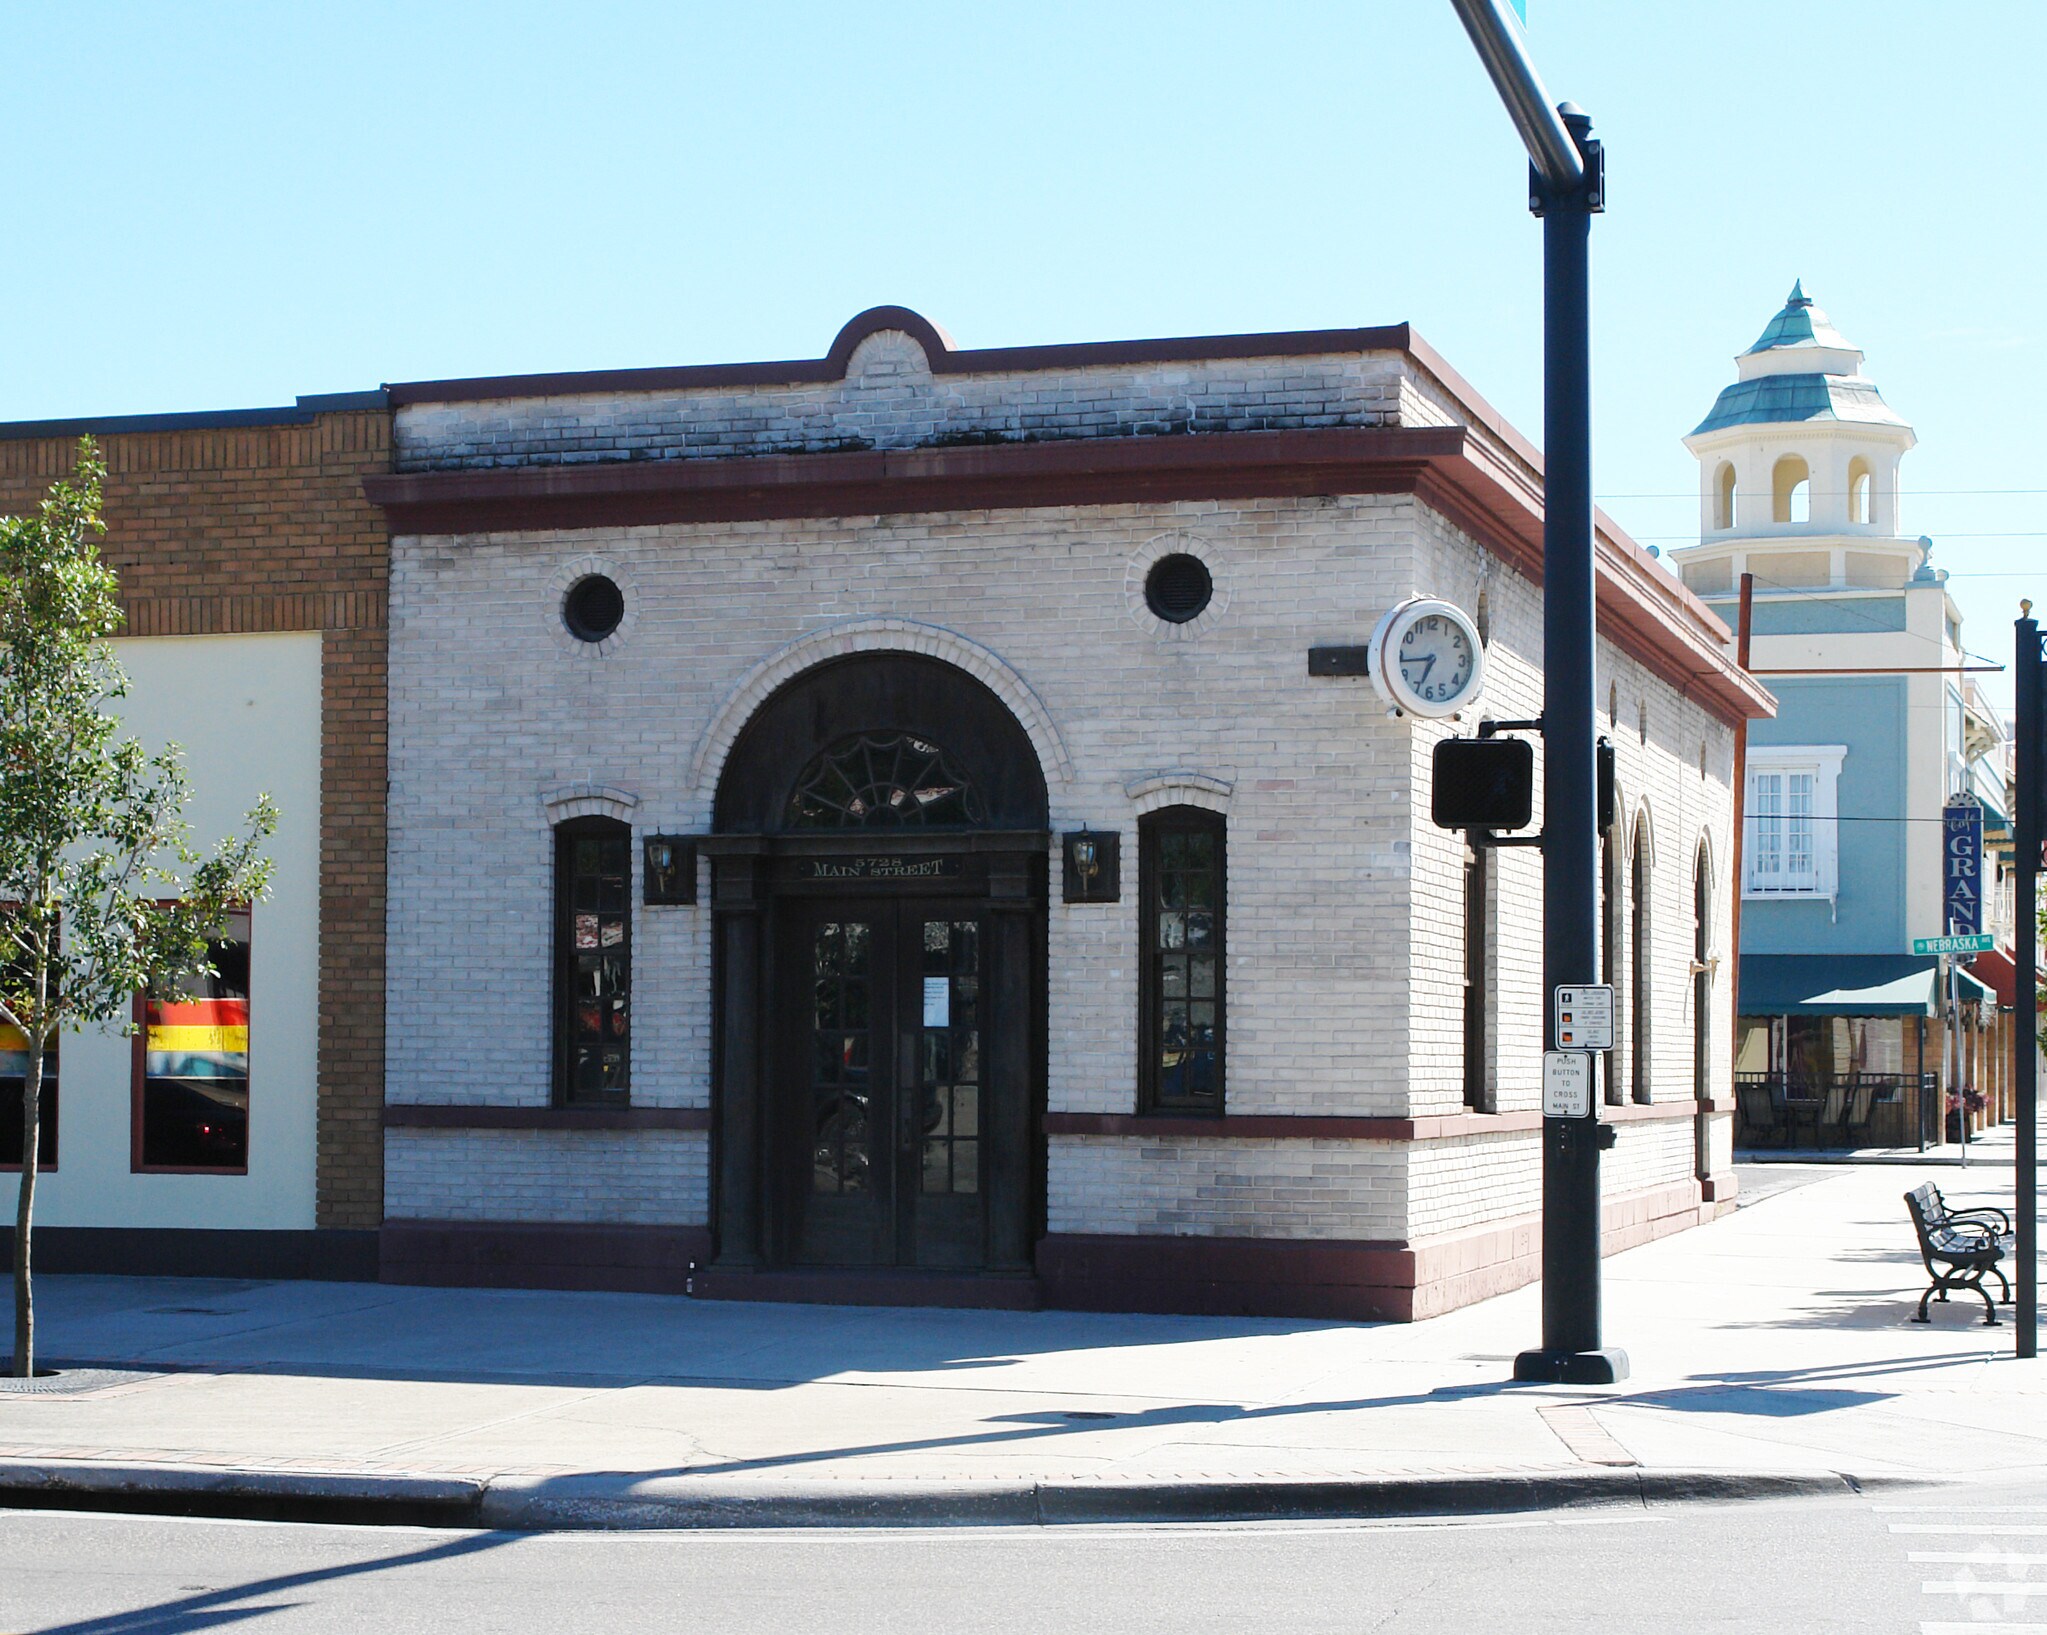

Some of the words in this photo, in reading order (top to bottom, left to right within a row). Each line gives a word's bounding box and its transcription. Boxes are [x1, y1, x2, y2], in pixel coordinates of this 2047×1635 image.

[1415, 621, 1423, 634] 11
[1427, 619, 1438, 631] 12
[1453, 635, 1461, 648] 2
[1458, 654, 1466, 668] 3
[1452, 672, 1459, 686] 4
[1413, 681, 1421, 694] 7
[1425, 686, 1433, 699] 6
[1438, 683, 1446, 697] 5
[813, 862, 861, 877] MAIN
[870, 859, 943, 876] STREET
[855, 858, 902, 867] 5728
[1926, 937, 1979, 952] NEBRASKA
[1553, 1091, 1578, 1099] CROSS
